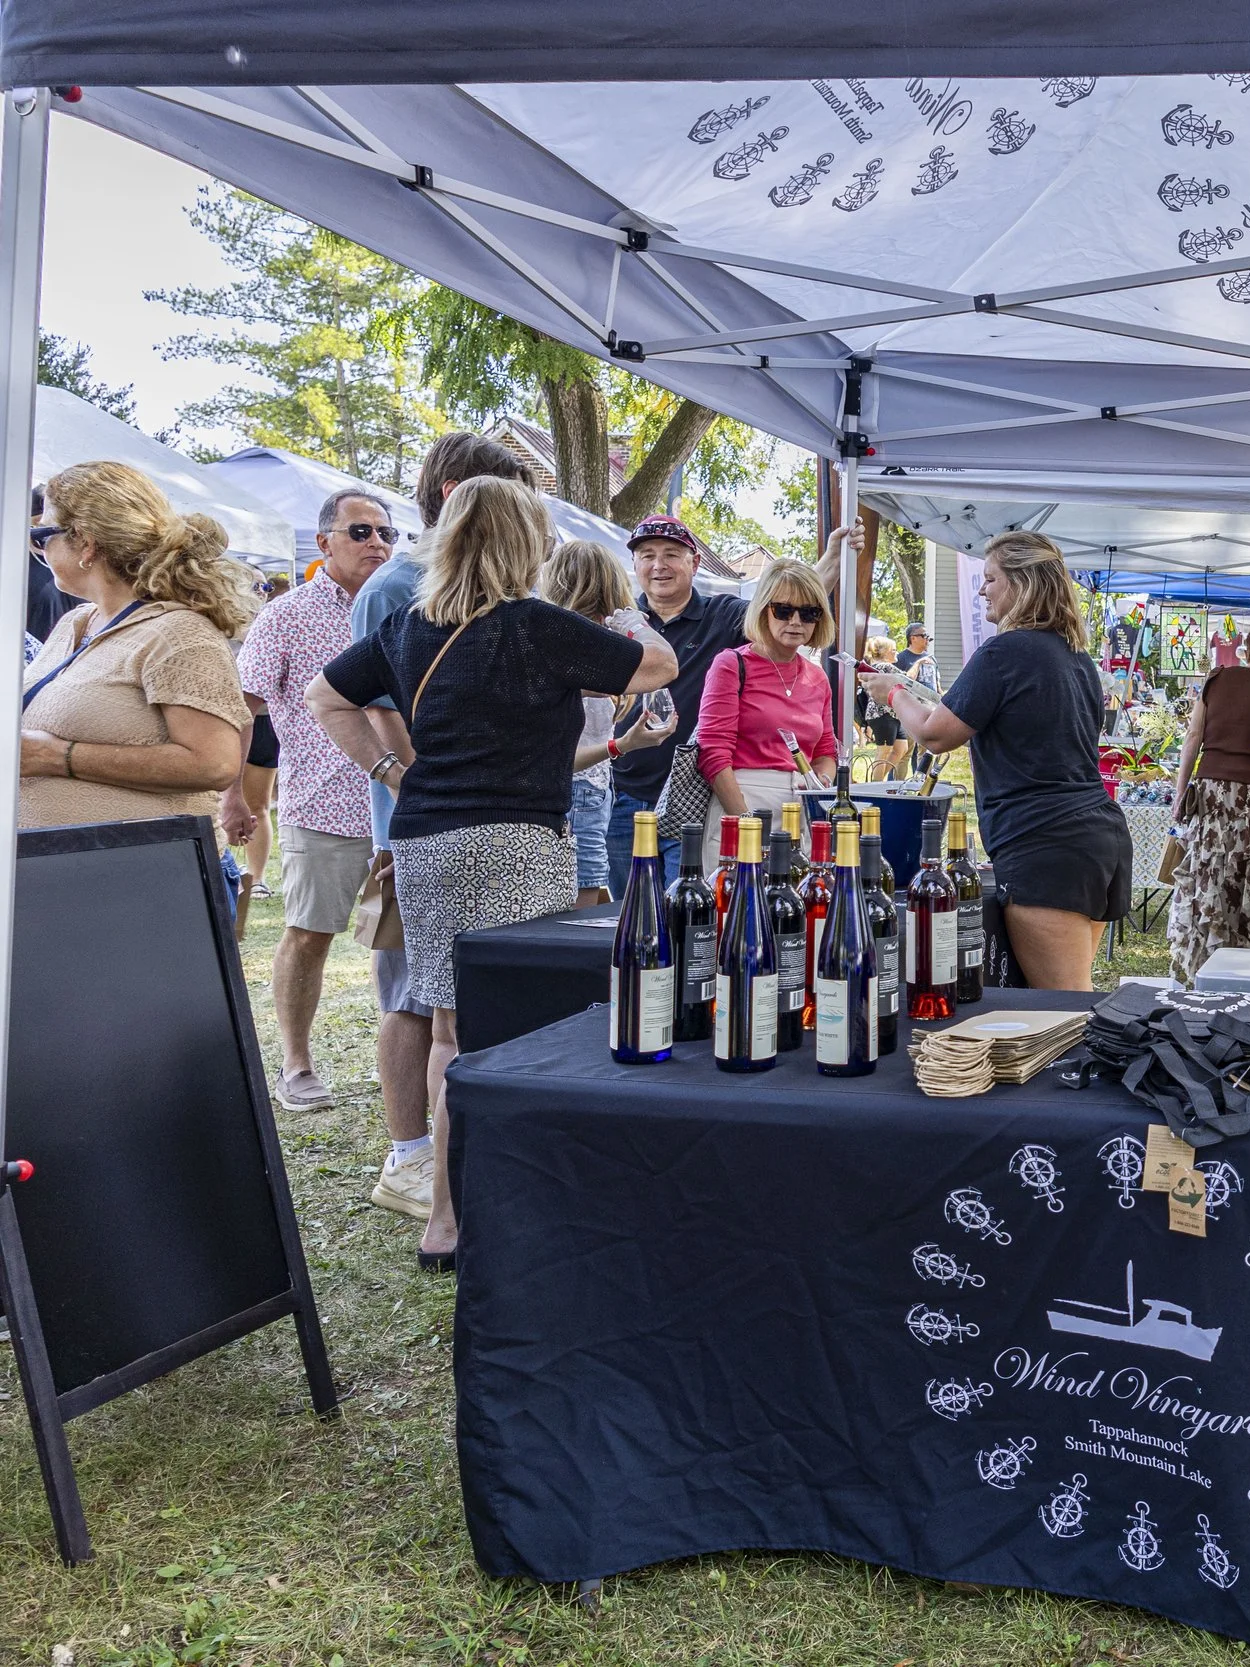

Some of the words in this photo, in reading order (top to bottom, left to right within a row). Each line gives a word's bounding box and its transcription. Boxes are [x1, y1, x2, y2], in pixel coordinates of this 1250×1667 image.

[994, 1346, 1105, 1399] Wind
[1064, 1435, 1107, 1456] Smith
[1110, 1444, 1177, 1475] Mountain
[1180, 1464, 1213, 1489] Lake
[1088, 1418, 1189, 1458] Tappahannock
